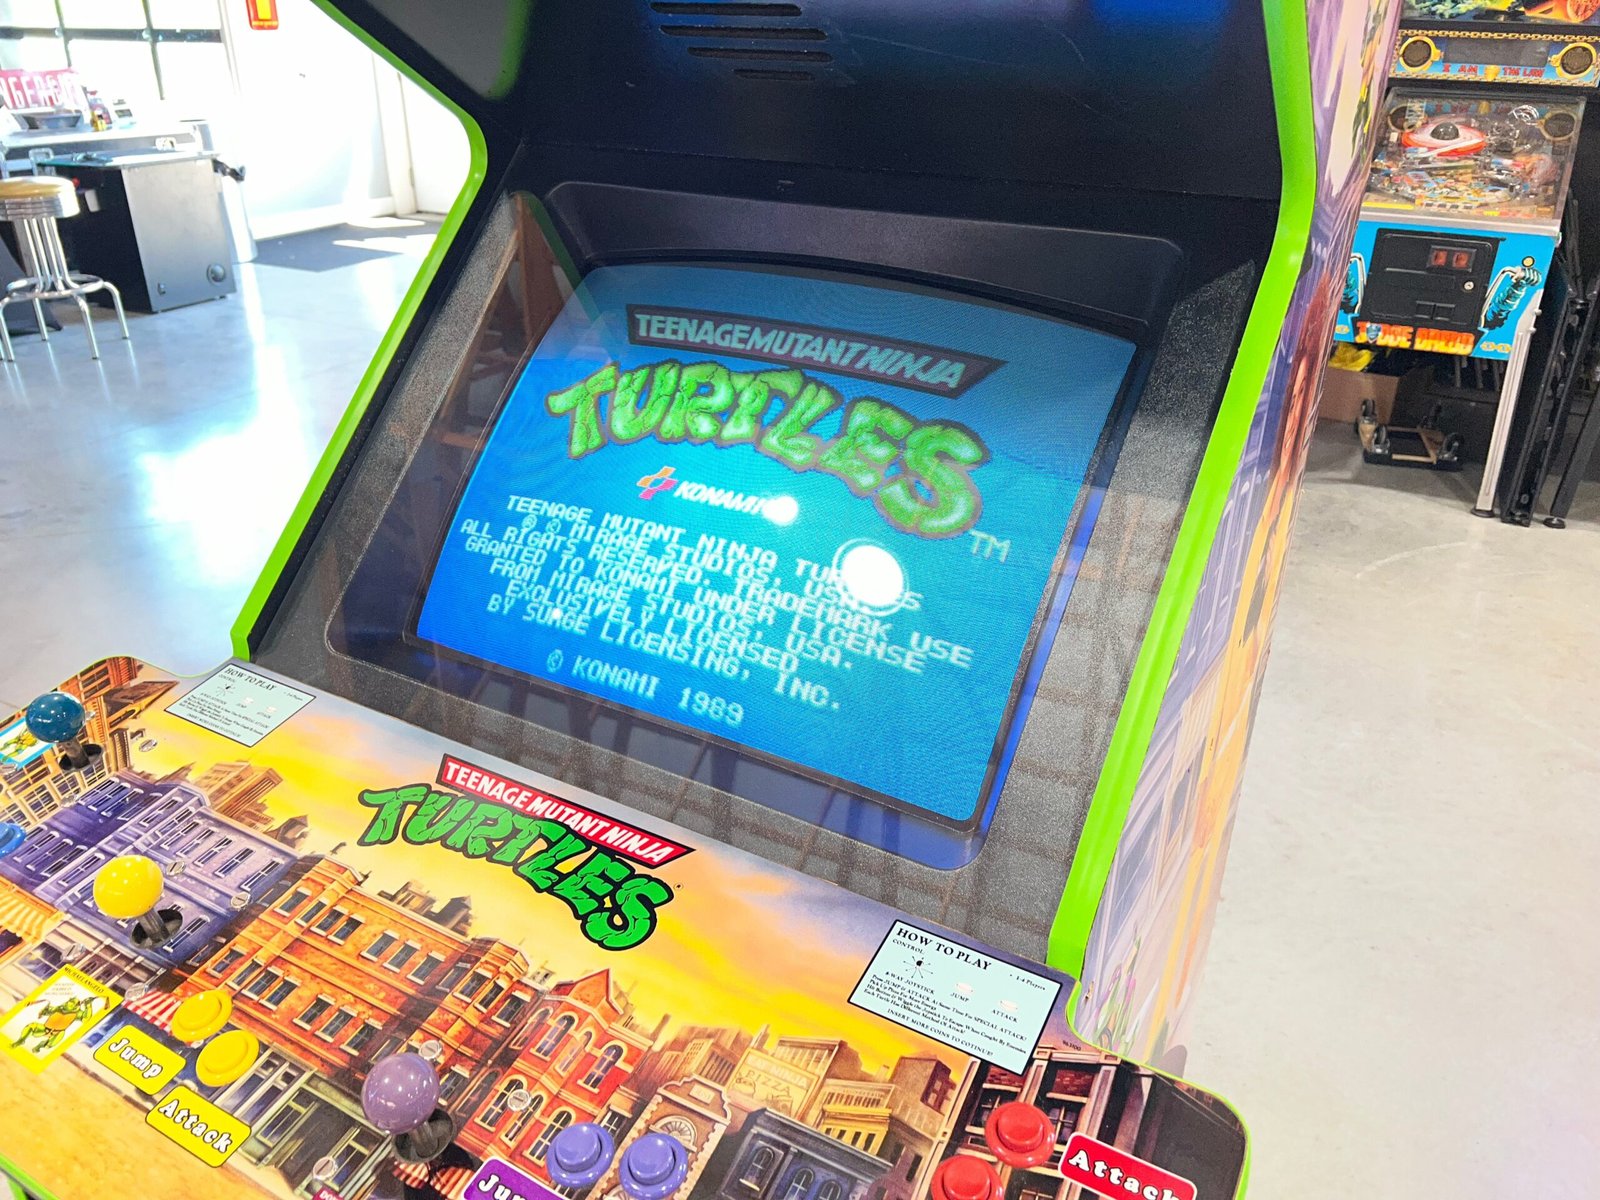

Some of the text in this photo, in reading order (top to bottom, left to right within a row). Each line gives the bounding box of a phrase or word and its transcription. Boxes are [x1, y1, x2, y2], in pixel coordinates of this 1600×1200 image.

[1458, 64, 1478, 74] AM
[1503, 67, 1520, 76] THE
[1523, 67, 1546, 78] LAW
[635, 313, 968, 389] TEENAGE MUTANT NINJA
[546, 359, 989, 538] TURTLES
[674, 481, 765, 514] KONAMI
[508, 495, 592, 524] TEENAGE
[602, 512, 686, 543] MUTANT
[697, 533, 778, 569] NINJA
[569, 523, 651, 550] MIRAGE
[665, 543, 782, 587] STUDIOS,
[967, 529, 1012, 563] TM
[460, 519, 492, 539] ALL
[588, 544, 711, 586] RESERVED.
[733, 577, 893, 641] TRADEMARK
[909, 630, 975, 670] USE
[465, 536, 928, 675] GRANTED TO KONAMI UNDER LICENSE
[490, 558, 853, 669] FROM MIRAGE STUDIOS, USA.
[486, 593, 516, 616] BY
[600, 620, 750, 682] LICENSING,
[774, 670, 840, 711] INC.
[506, 579, 798, 674] EXCLUSIVELY LICENSED
[225, 667, 277, 691] HOW TO PLAY
[571, 655, 660, 699] KONAMI
[678, 687, 744, 728] 1989
[444, 761, 676, 863] TEENAGE MUTANT NINJA
[358, 783, 675, 951] TURTLES
[895, 927, 992, 971] HOW TO PLAY
[904, 978, 935, 994] JOYSTICK
[906, 988, 931, 1001] ATTACK
[972, 1016, 998, 1029] SPECIAL
[949, 991, 969, 1002] JUMP
[886, 1008, 910, 1021] INSERT
[910, 1018, 929, 1029] MORE
[928, 1025, 950, 1038] COINS
[950, 1035, 961, 1043] TO
[991, 1008, 1018, 1023] ATTACK
[109, 1038, 163, 1079] Jump
[745, 1069, 791, 1097] PIZZA
[158, 1099, 233, 1153] Attack
